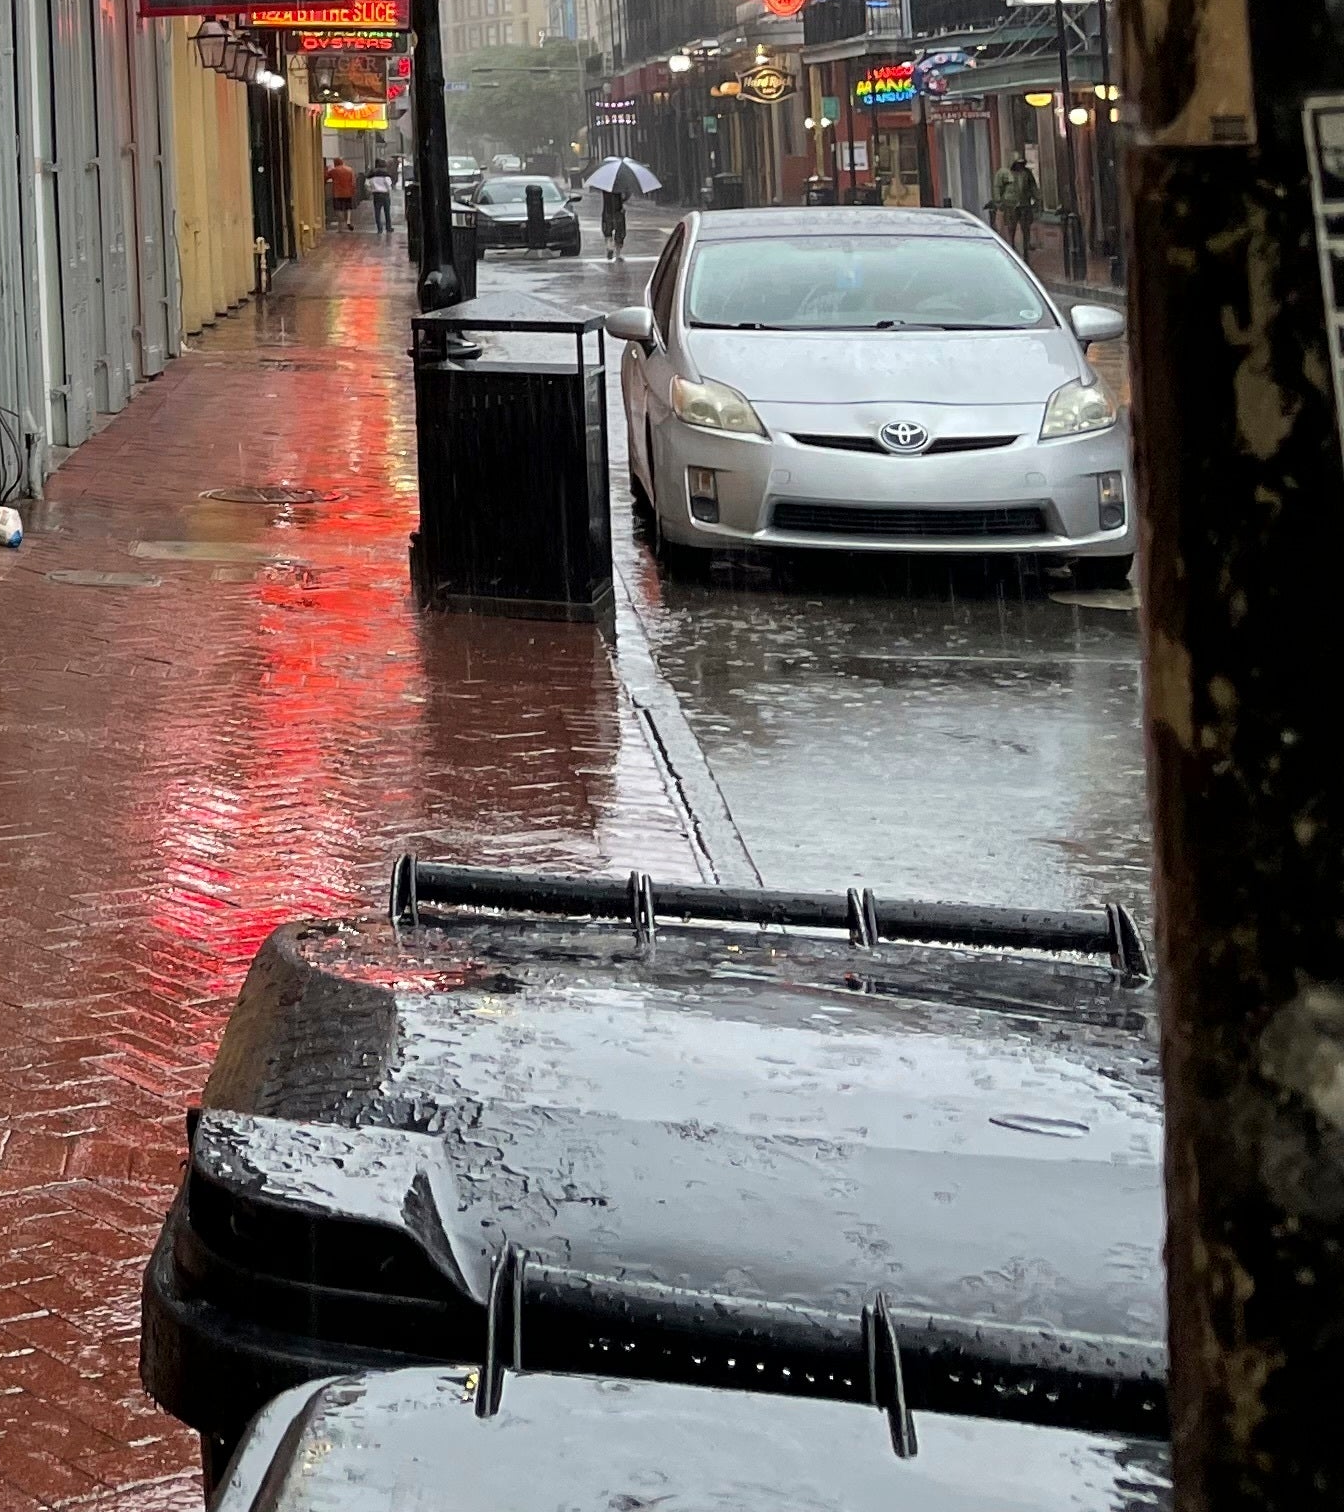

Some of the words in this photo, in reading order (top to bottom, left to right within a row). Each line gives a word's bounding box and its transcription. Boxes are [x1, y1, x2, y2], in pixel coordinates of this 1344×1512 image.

[352, 1, 397, 22] SLICE
[303, 38, 393, 49] OYSTERS
[331, 56, 376, 70] IGAR
